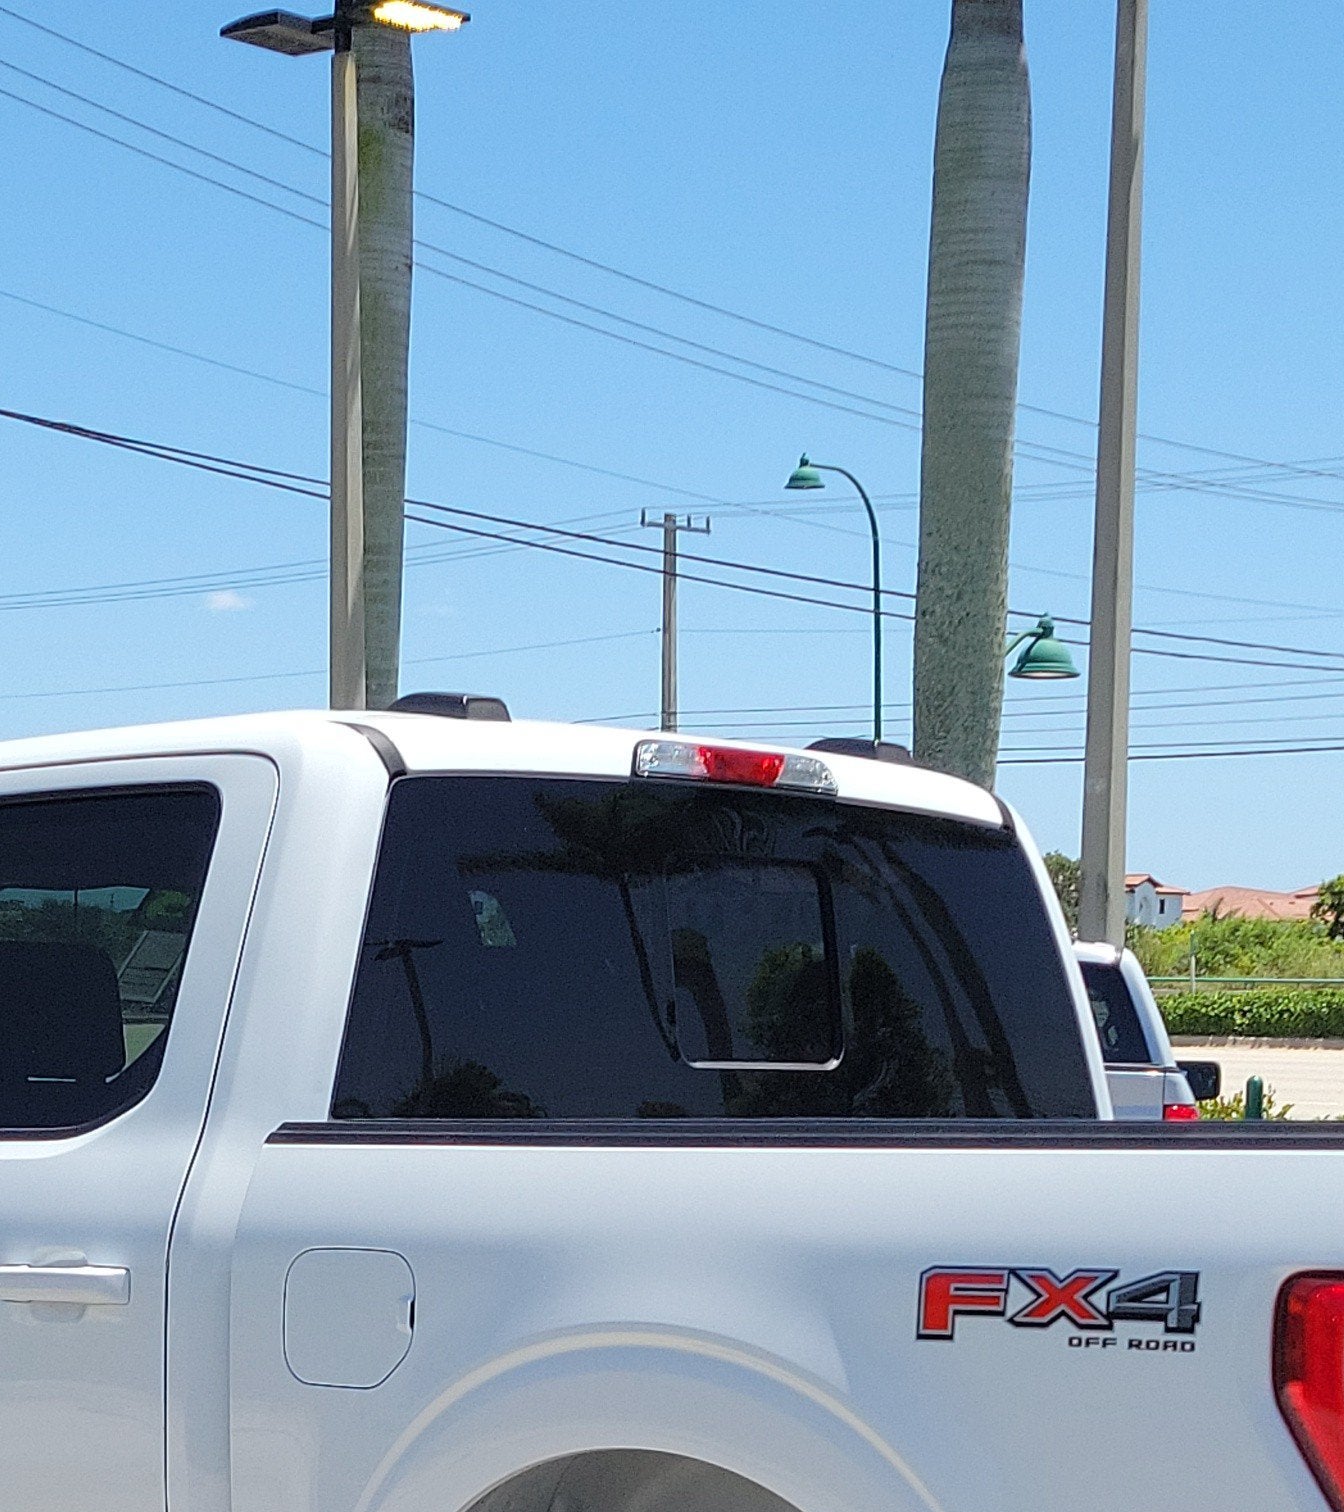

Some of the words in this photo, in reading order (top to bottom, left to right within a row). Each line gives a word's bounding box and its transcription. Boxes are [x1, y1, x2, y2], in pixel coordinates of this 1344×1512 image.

[916, 1265, 1201, 1341] FX4
[1068, 1337, 1118, 1349] OFF
[1128, 1339, 1196, 1353] ROAD
